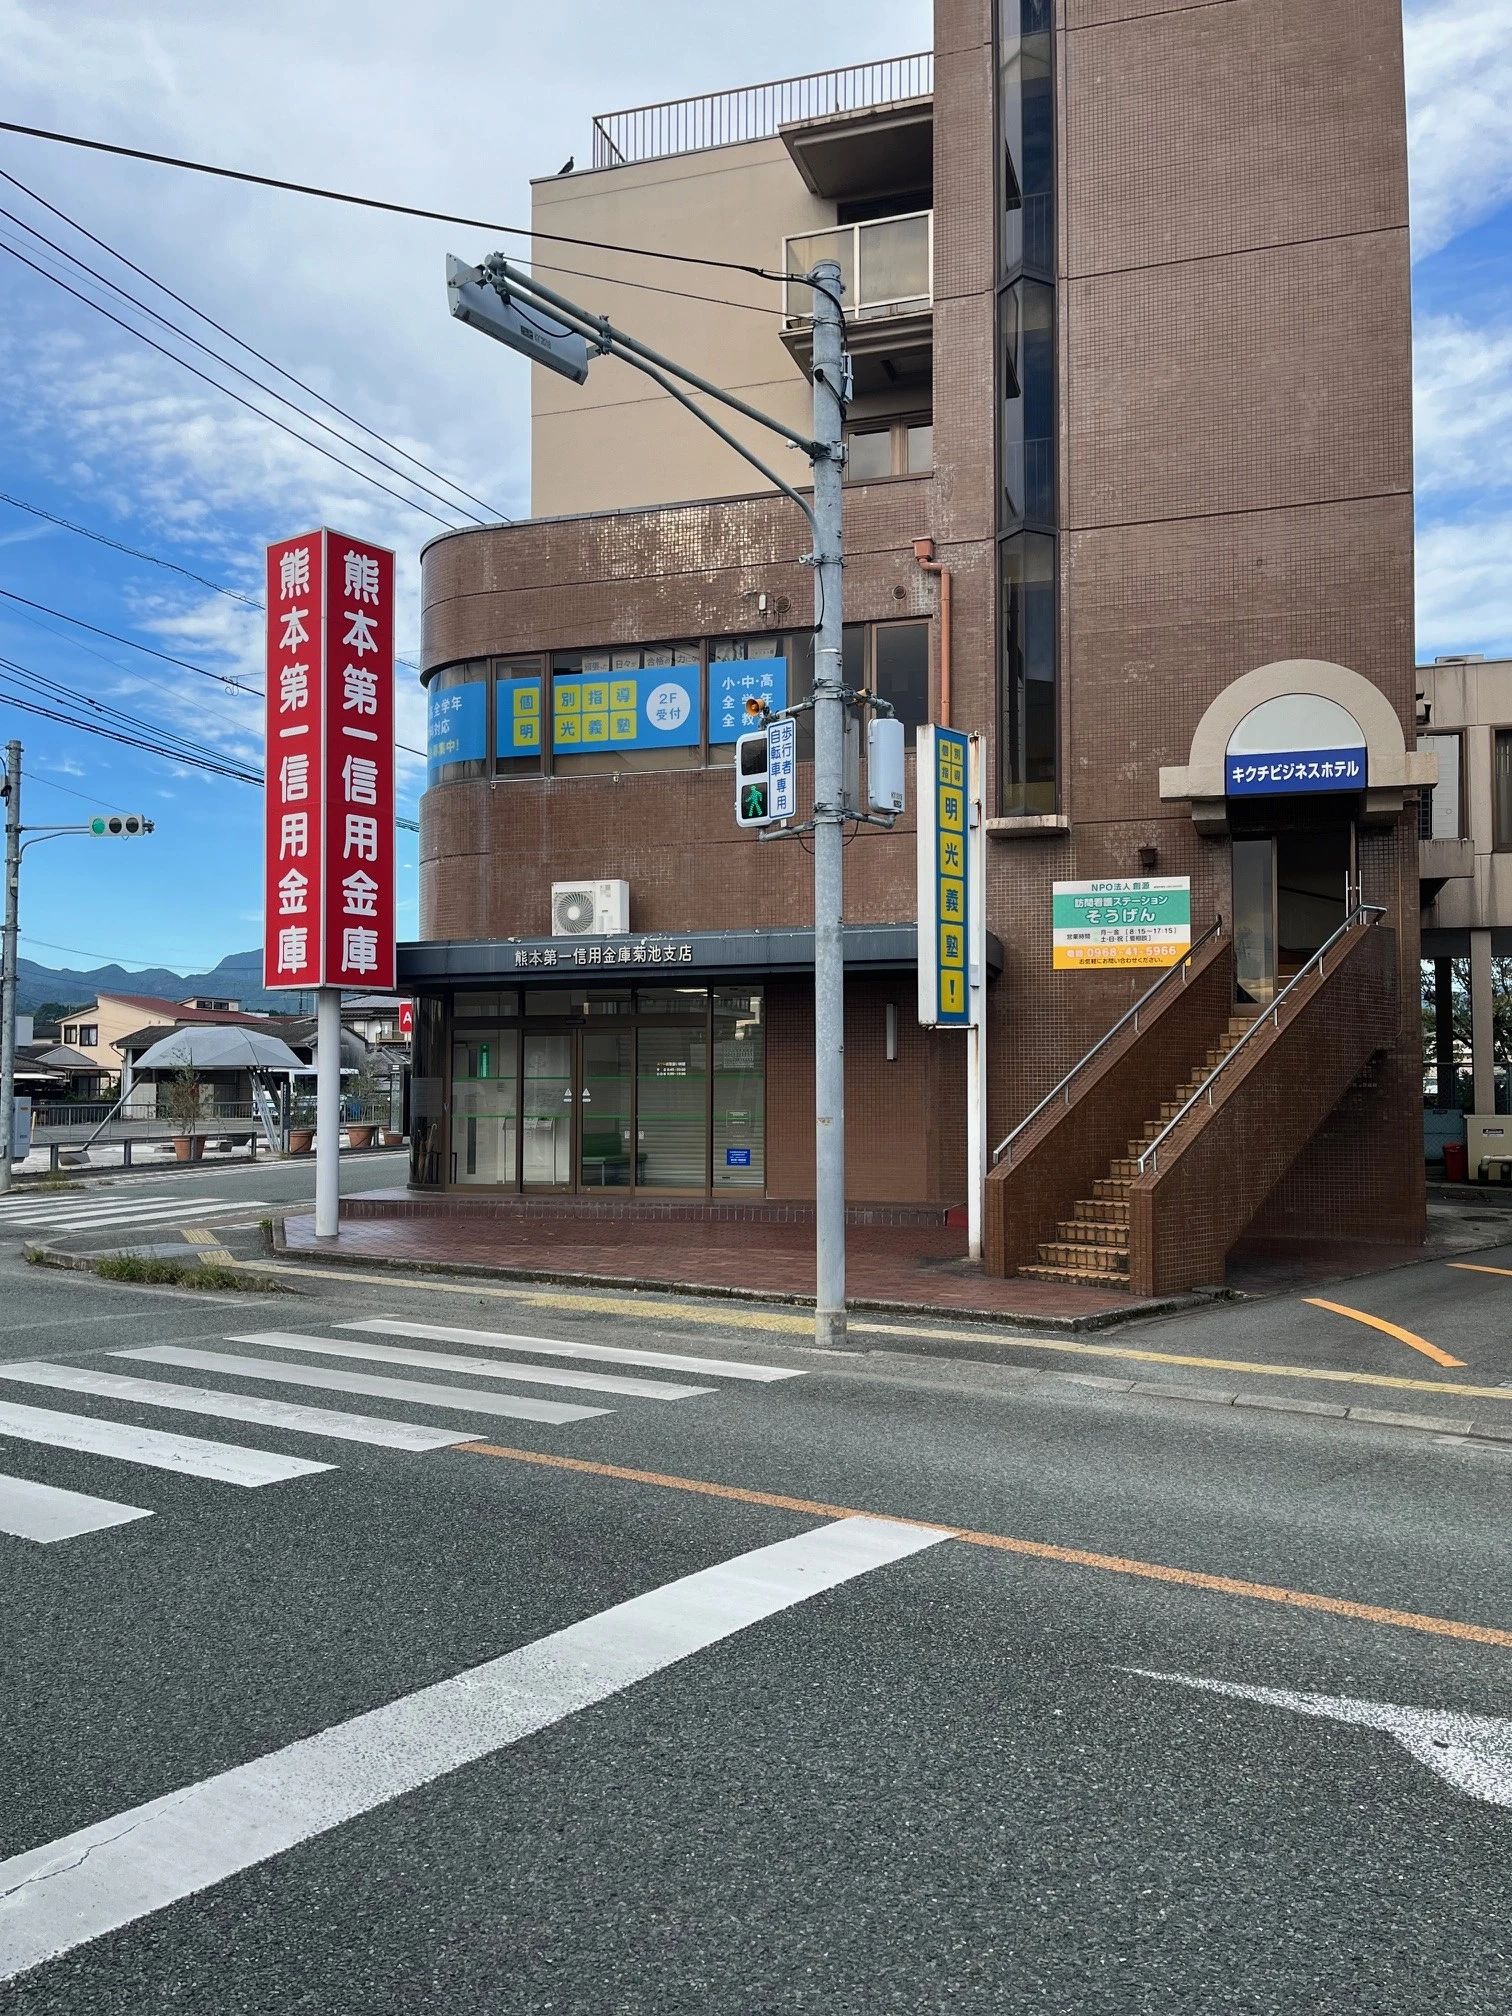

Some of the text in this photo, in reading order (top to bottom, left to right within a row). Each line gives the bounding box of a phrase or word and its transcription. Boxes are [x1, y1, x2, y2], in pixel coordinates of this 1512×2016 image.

[519, 687, 631, 710] 個別指導
[659, 692, 677, 705] 2F
[656, 707, 681, 721] 受付
[519, 718, 631, 739] 明光義塾
[277, 546, 310, 975] 熊本第一信用金庫
[340, 549, 380, 975] 熊本第一信用金庫
[770, 729, 781, 776] 自転車
[781, 726, 792, 775] 歩行者
[1232, 760, 1360, 783] キクチビジネスホテル
[776, 778, 787, 810] 専用
[1085, 908, 1156, 924] そうげん
[514, 944, 692, 967] 熊本第一信用金庫菊池支店
